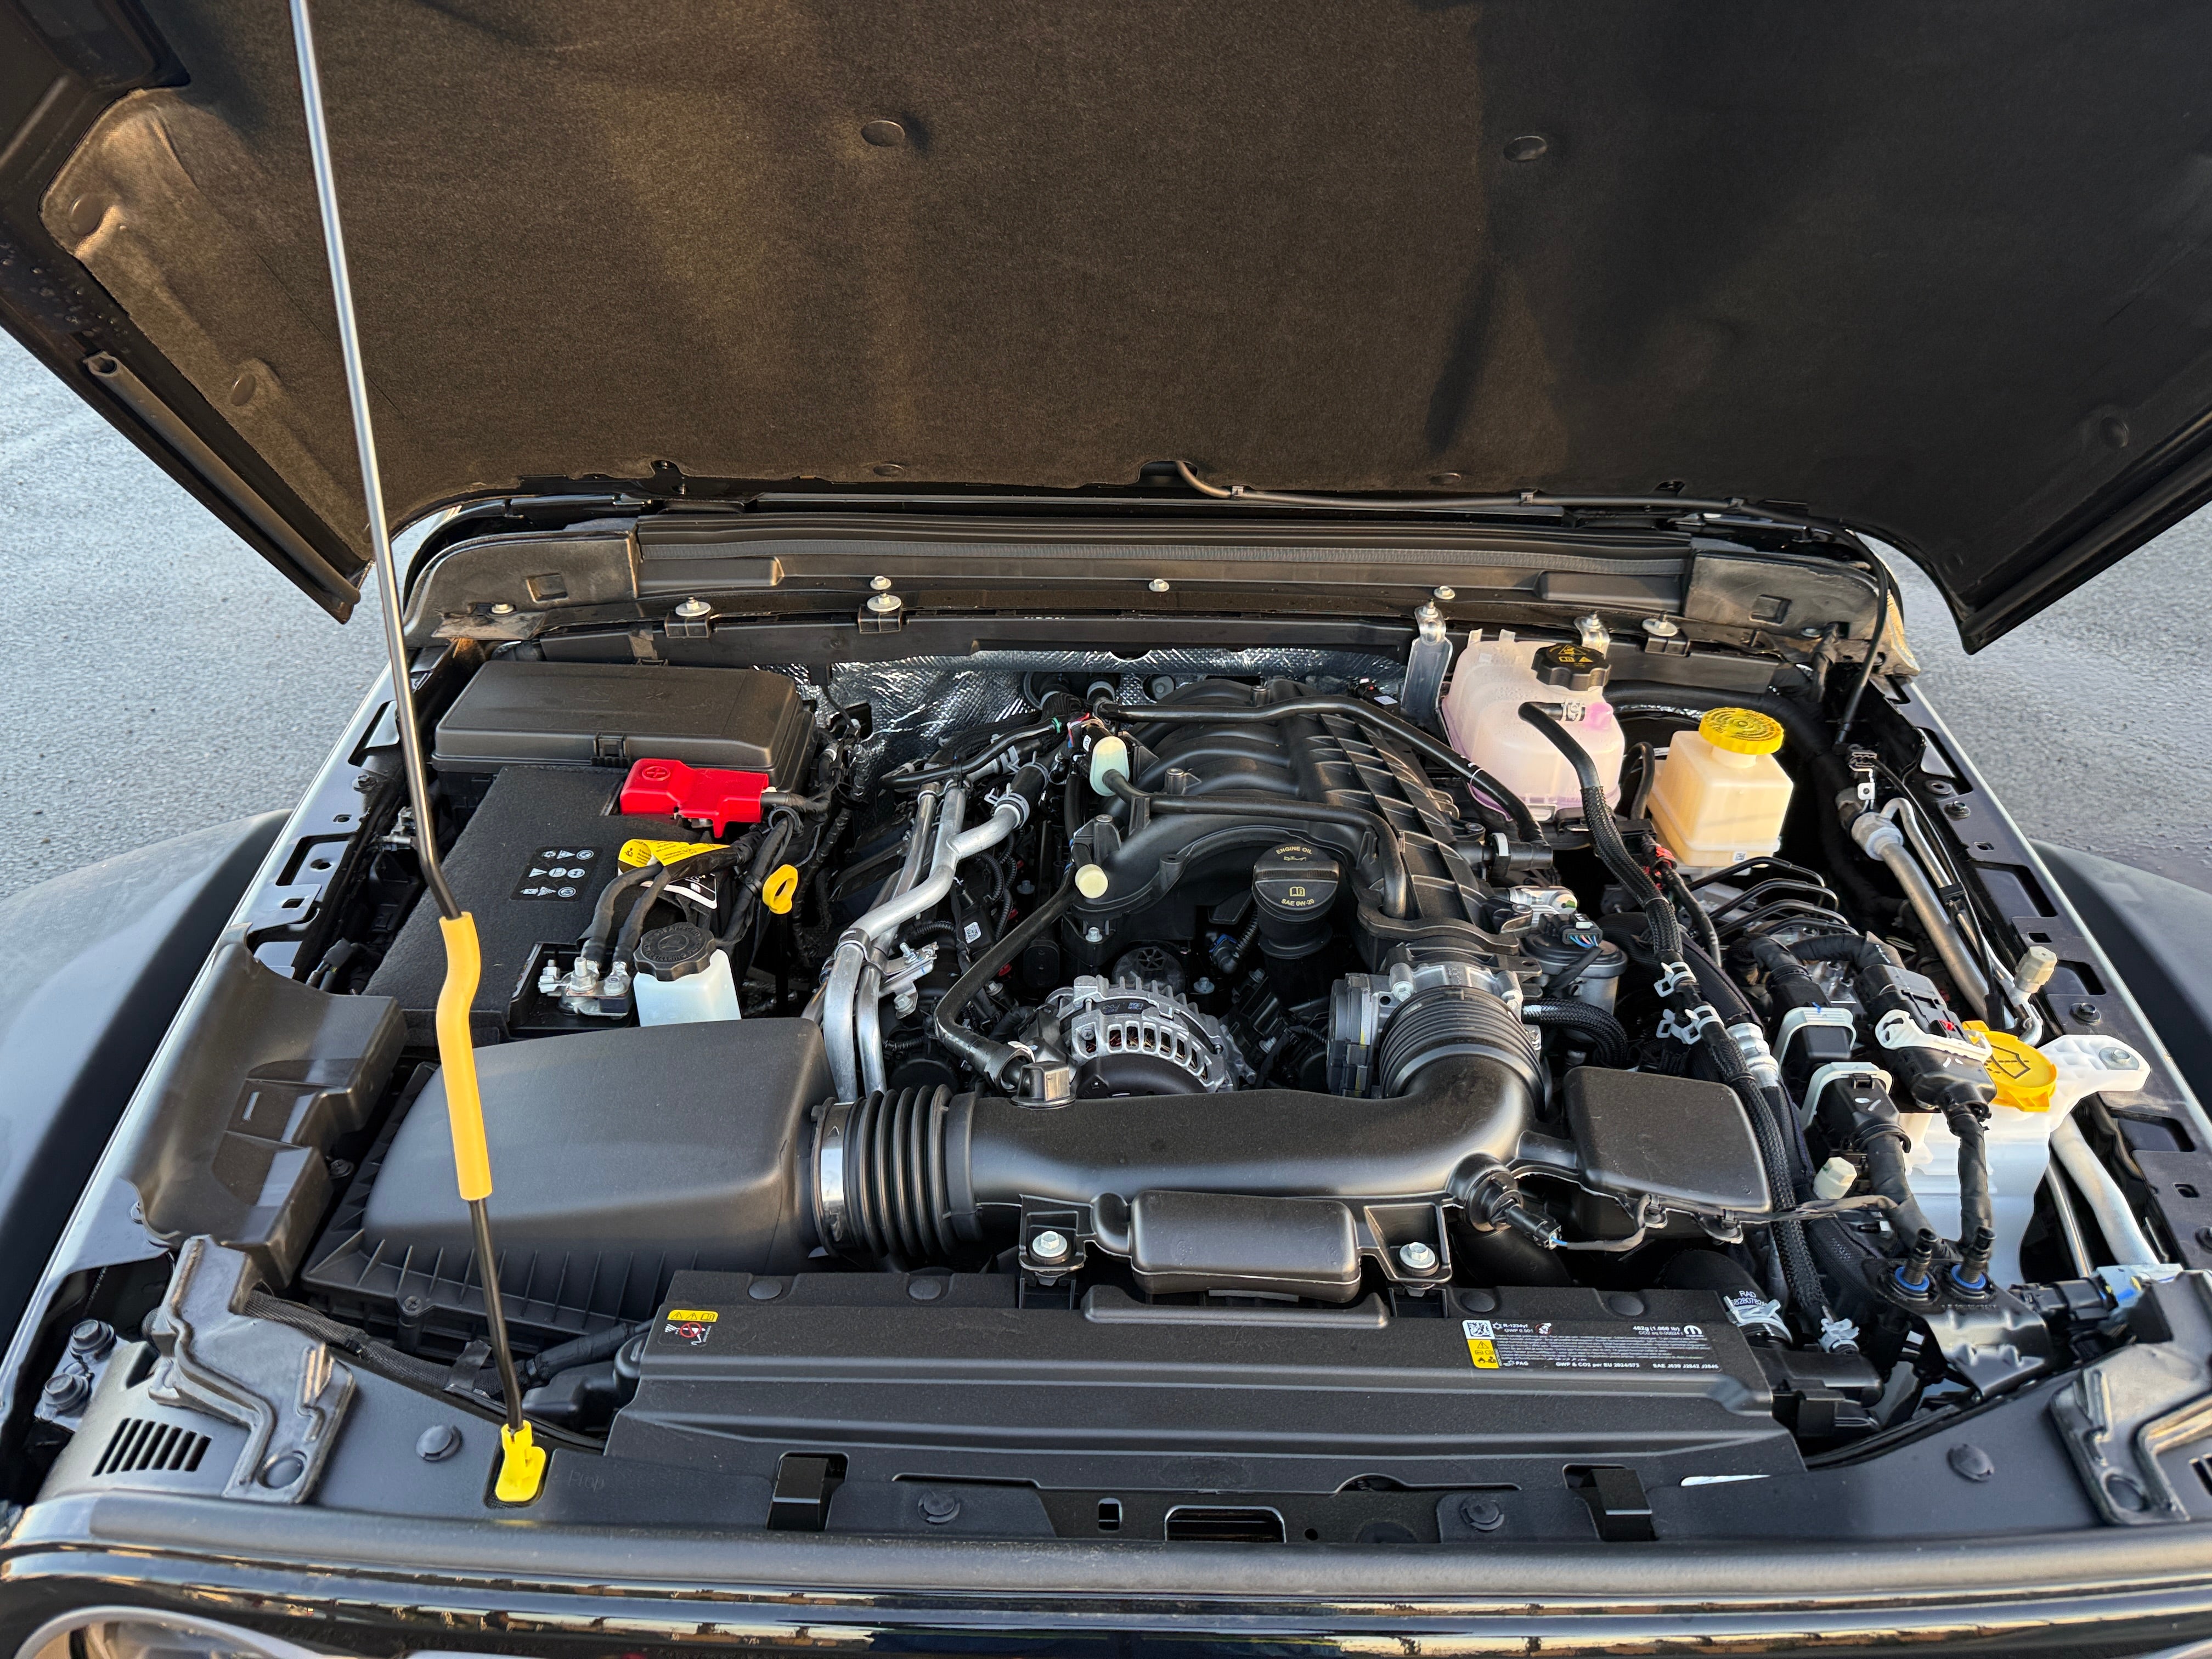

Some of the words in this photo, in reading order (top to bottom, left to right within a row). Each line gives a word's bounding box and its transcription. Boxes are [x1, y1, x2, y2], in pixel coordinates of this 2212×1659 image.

[1276, 846, 1301, 855] ENGINE
[1302, 847, 1313, 855] OIL
[1281, 898, 1295, 906] SAE
[1296, 898, 1315, 906] 0W-20
